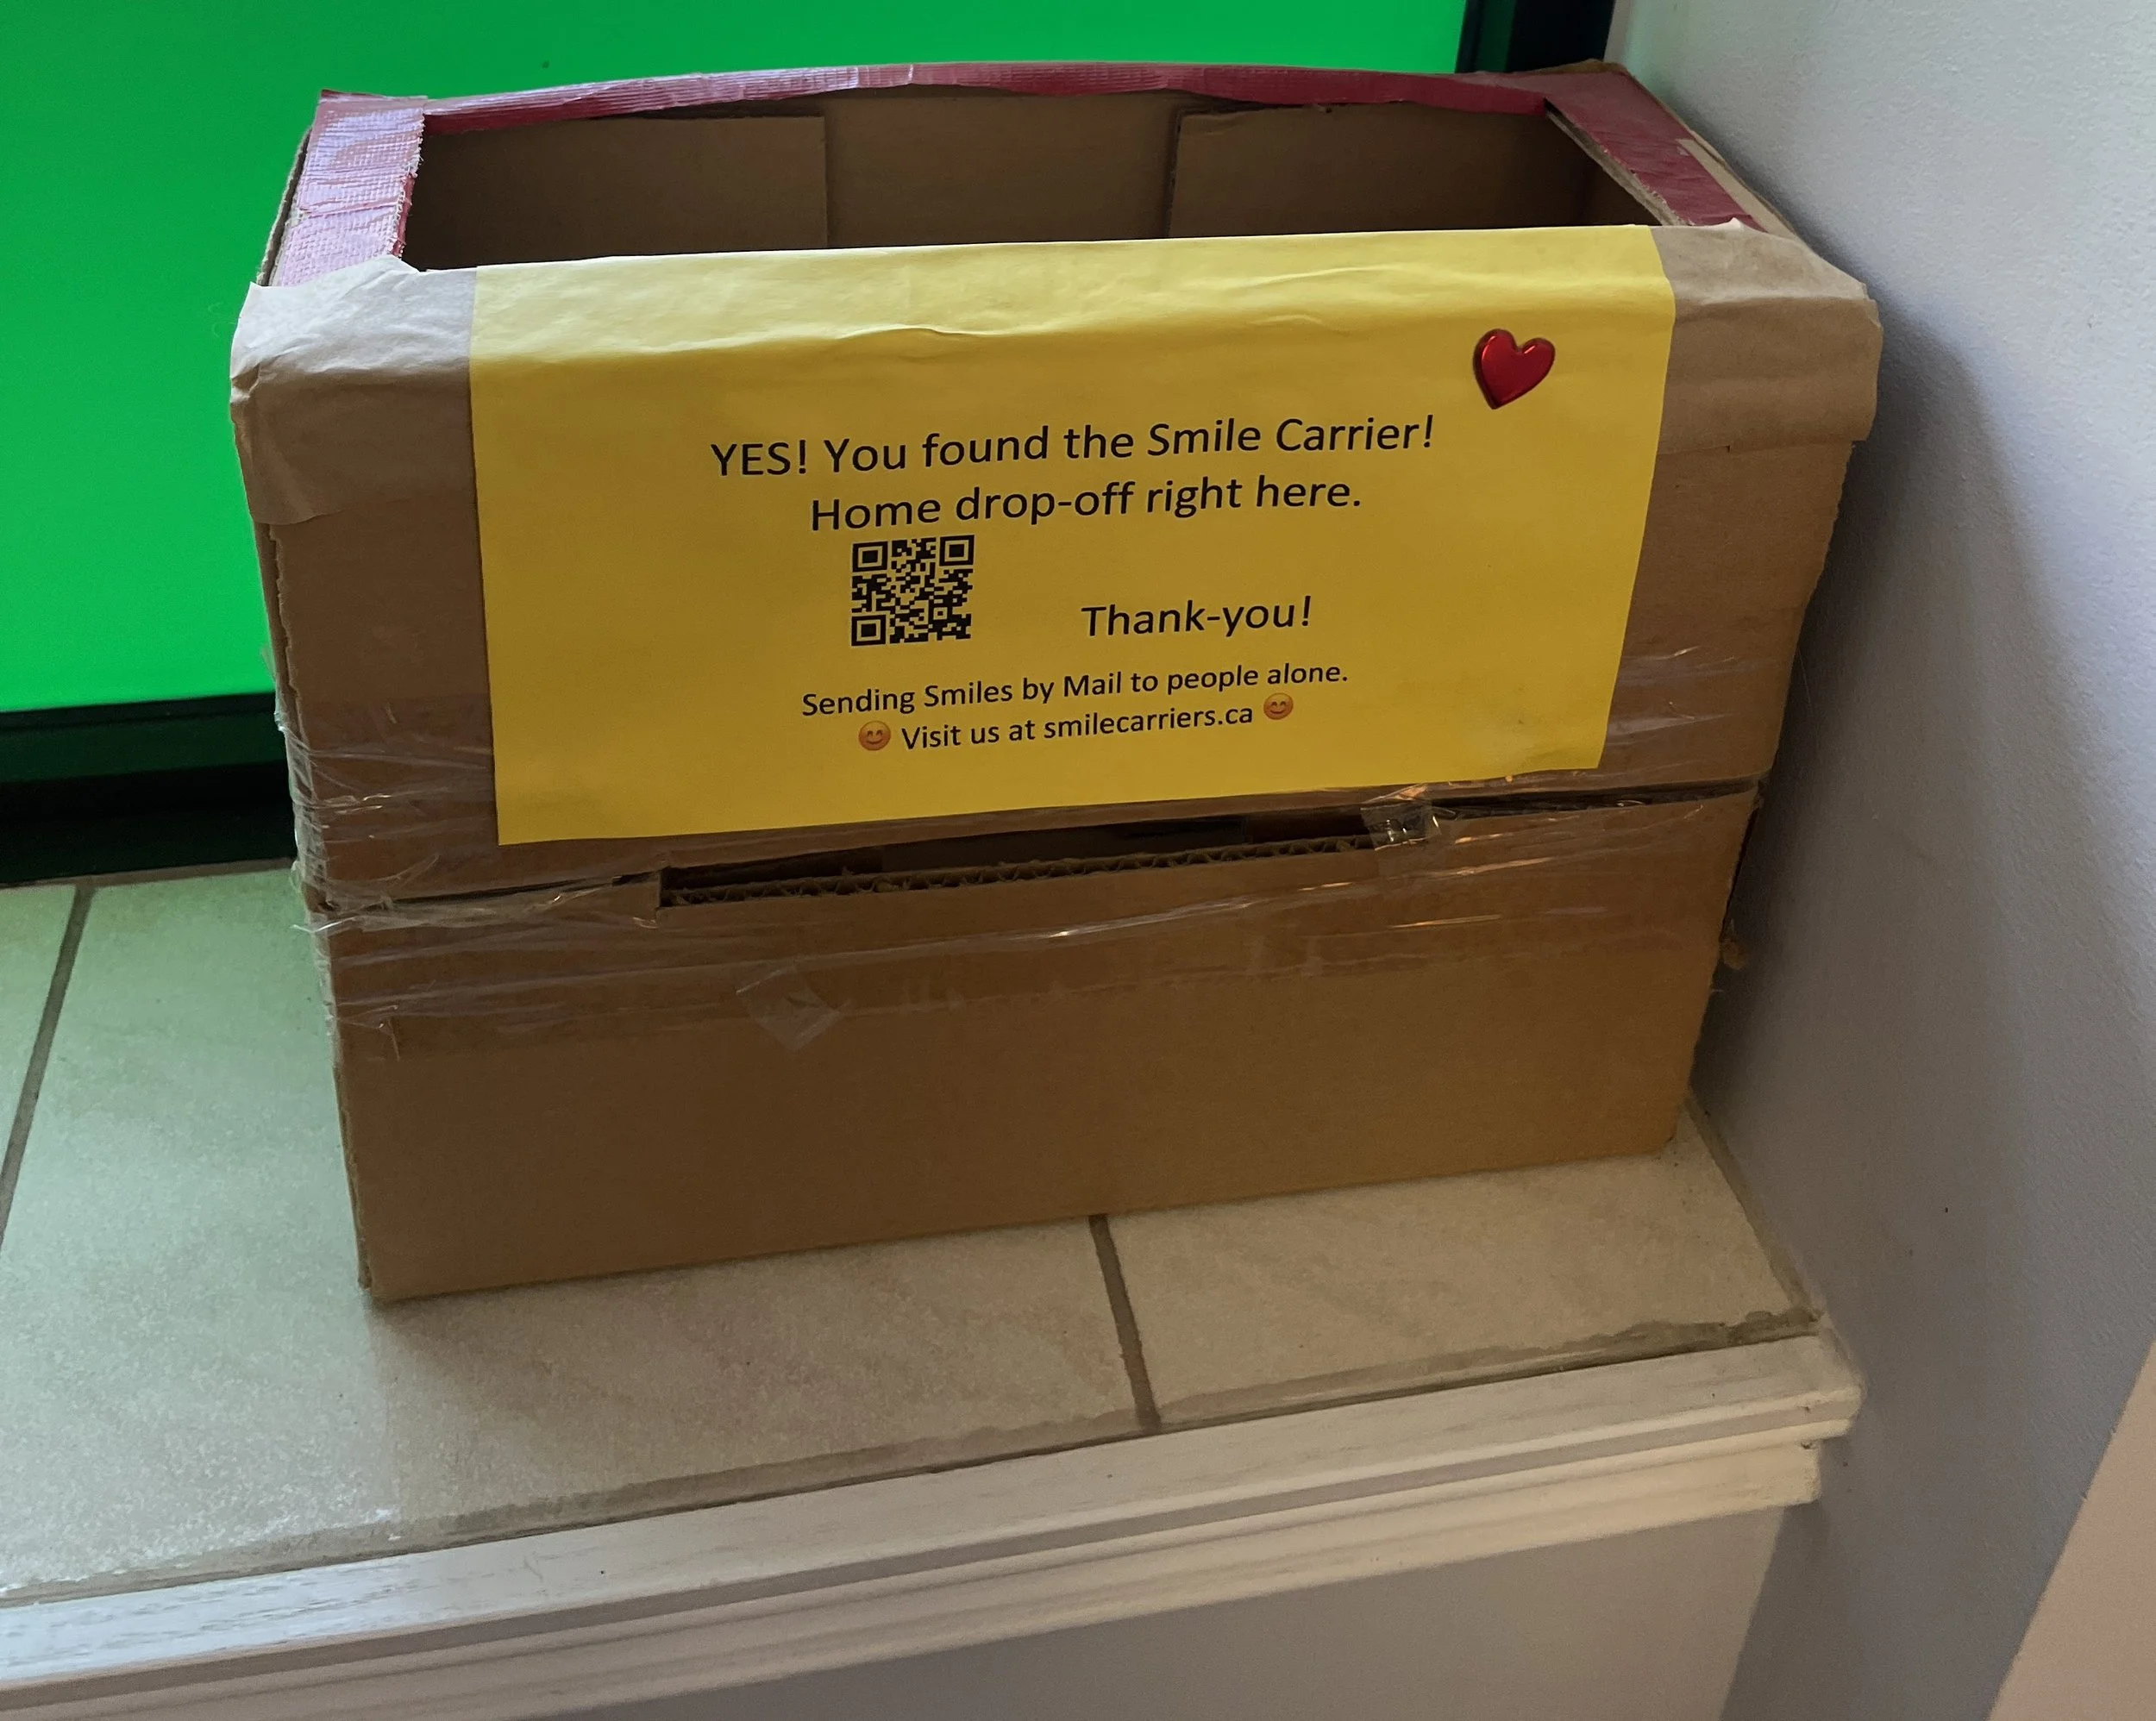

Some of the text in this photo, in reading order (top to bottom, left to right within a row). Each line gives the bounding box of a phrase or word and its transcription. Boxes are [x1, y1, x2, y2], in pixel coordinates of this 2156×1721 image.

[711, 414, 1433, 477] YES! You found the Smile Carrier!
[812, 474, 1361, 531] Home drop-off right here.
[1081, 595, 1312, 638] Thank-you!
[802, 662, 1348, 717] Sending Smiles by Mail to people alone.
[901, 707, 1253, 750] Visit us at smilecarriers.ca
